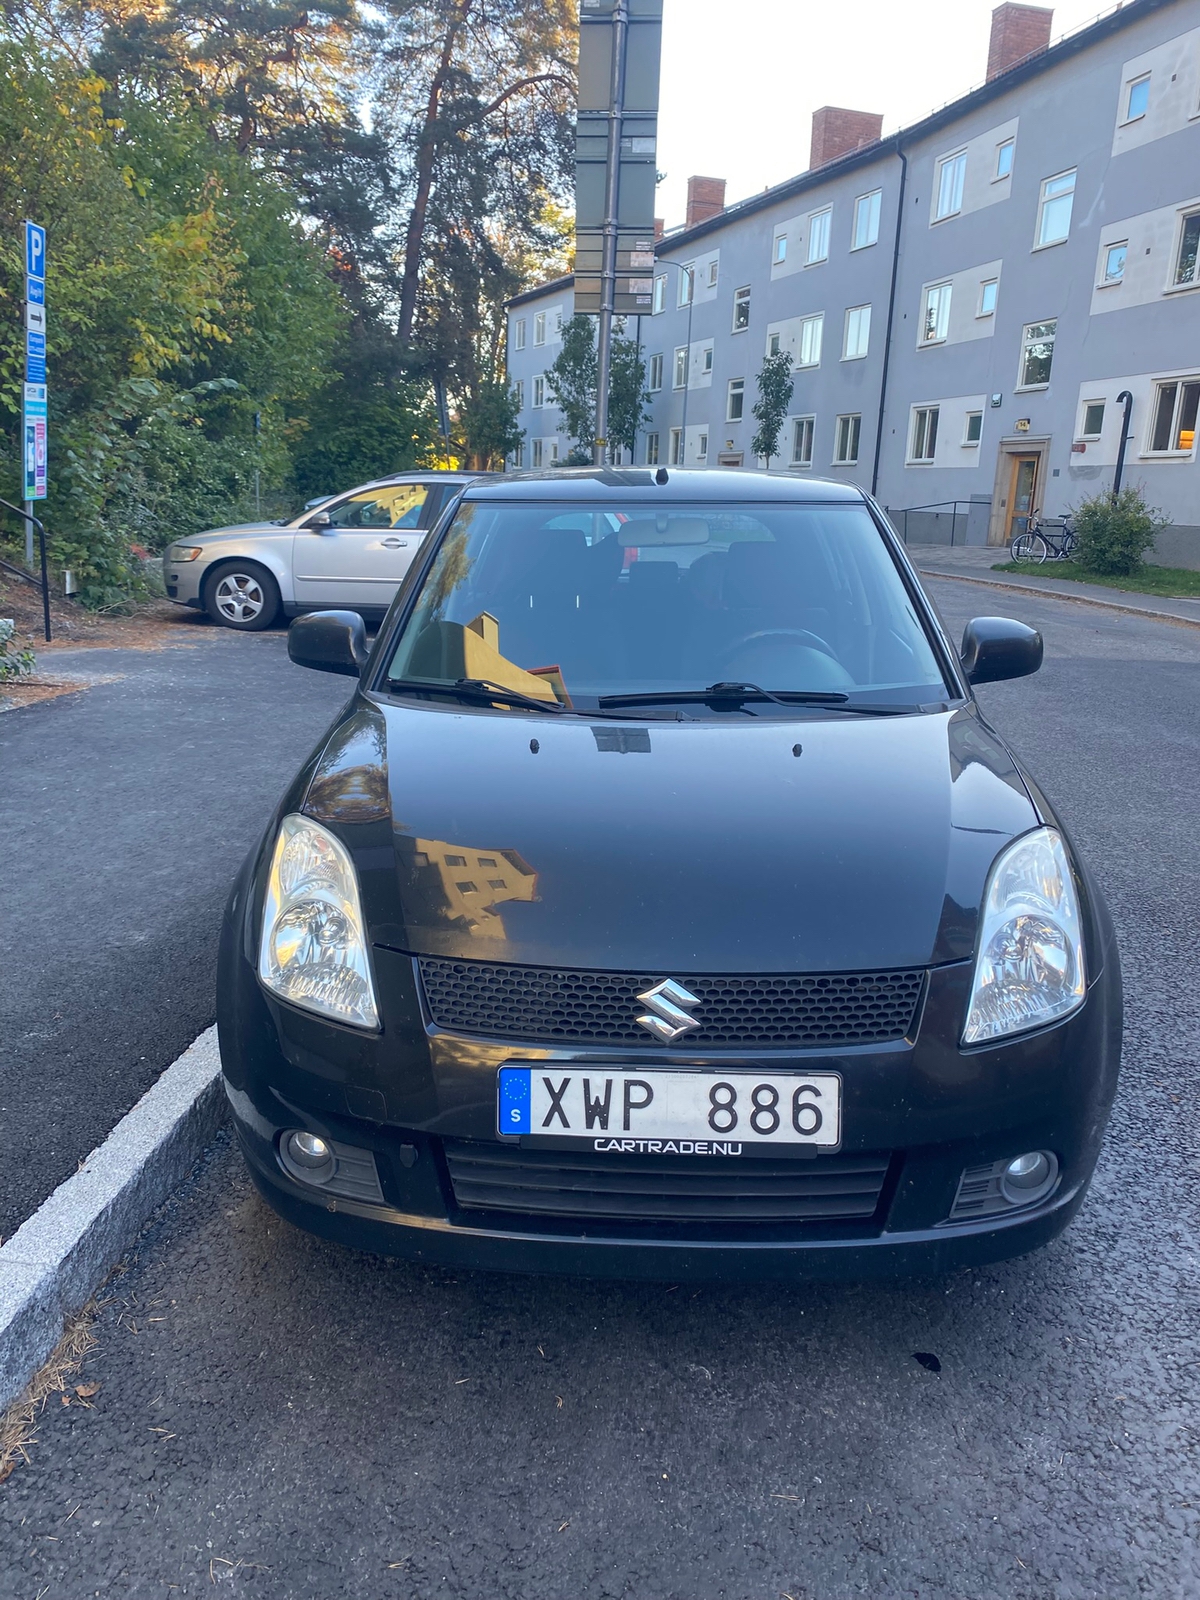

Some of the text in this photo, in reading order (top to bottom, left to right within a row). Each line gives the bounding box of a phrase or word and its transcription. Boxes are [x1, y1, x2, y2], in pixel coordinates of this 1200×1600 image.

[31, 230, 42, 271] P
[511, 1108, 521, 1122] S
[541, 1077, 824, 1136] XWP 886
[593, 1139, 743, 1156] CARTRADE.NU
